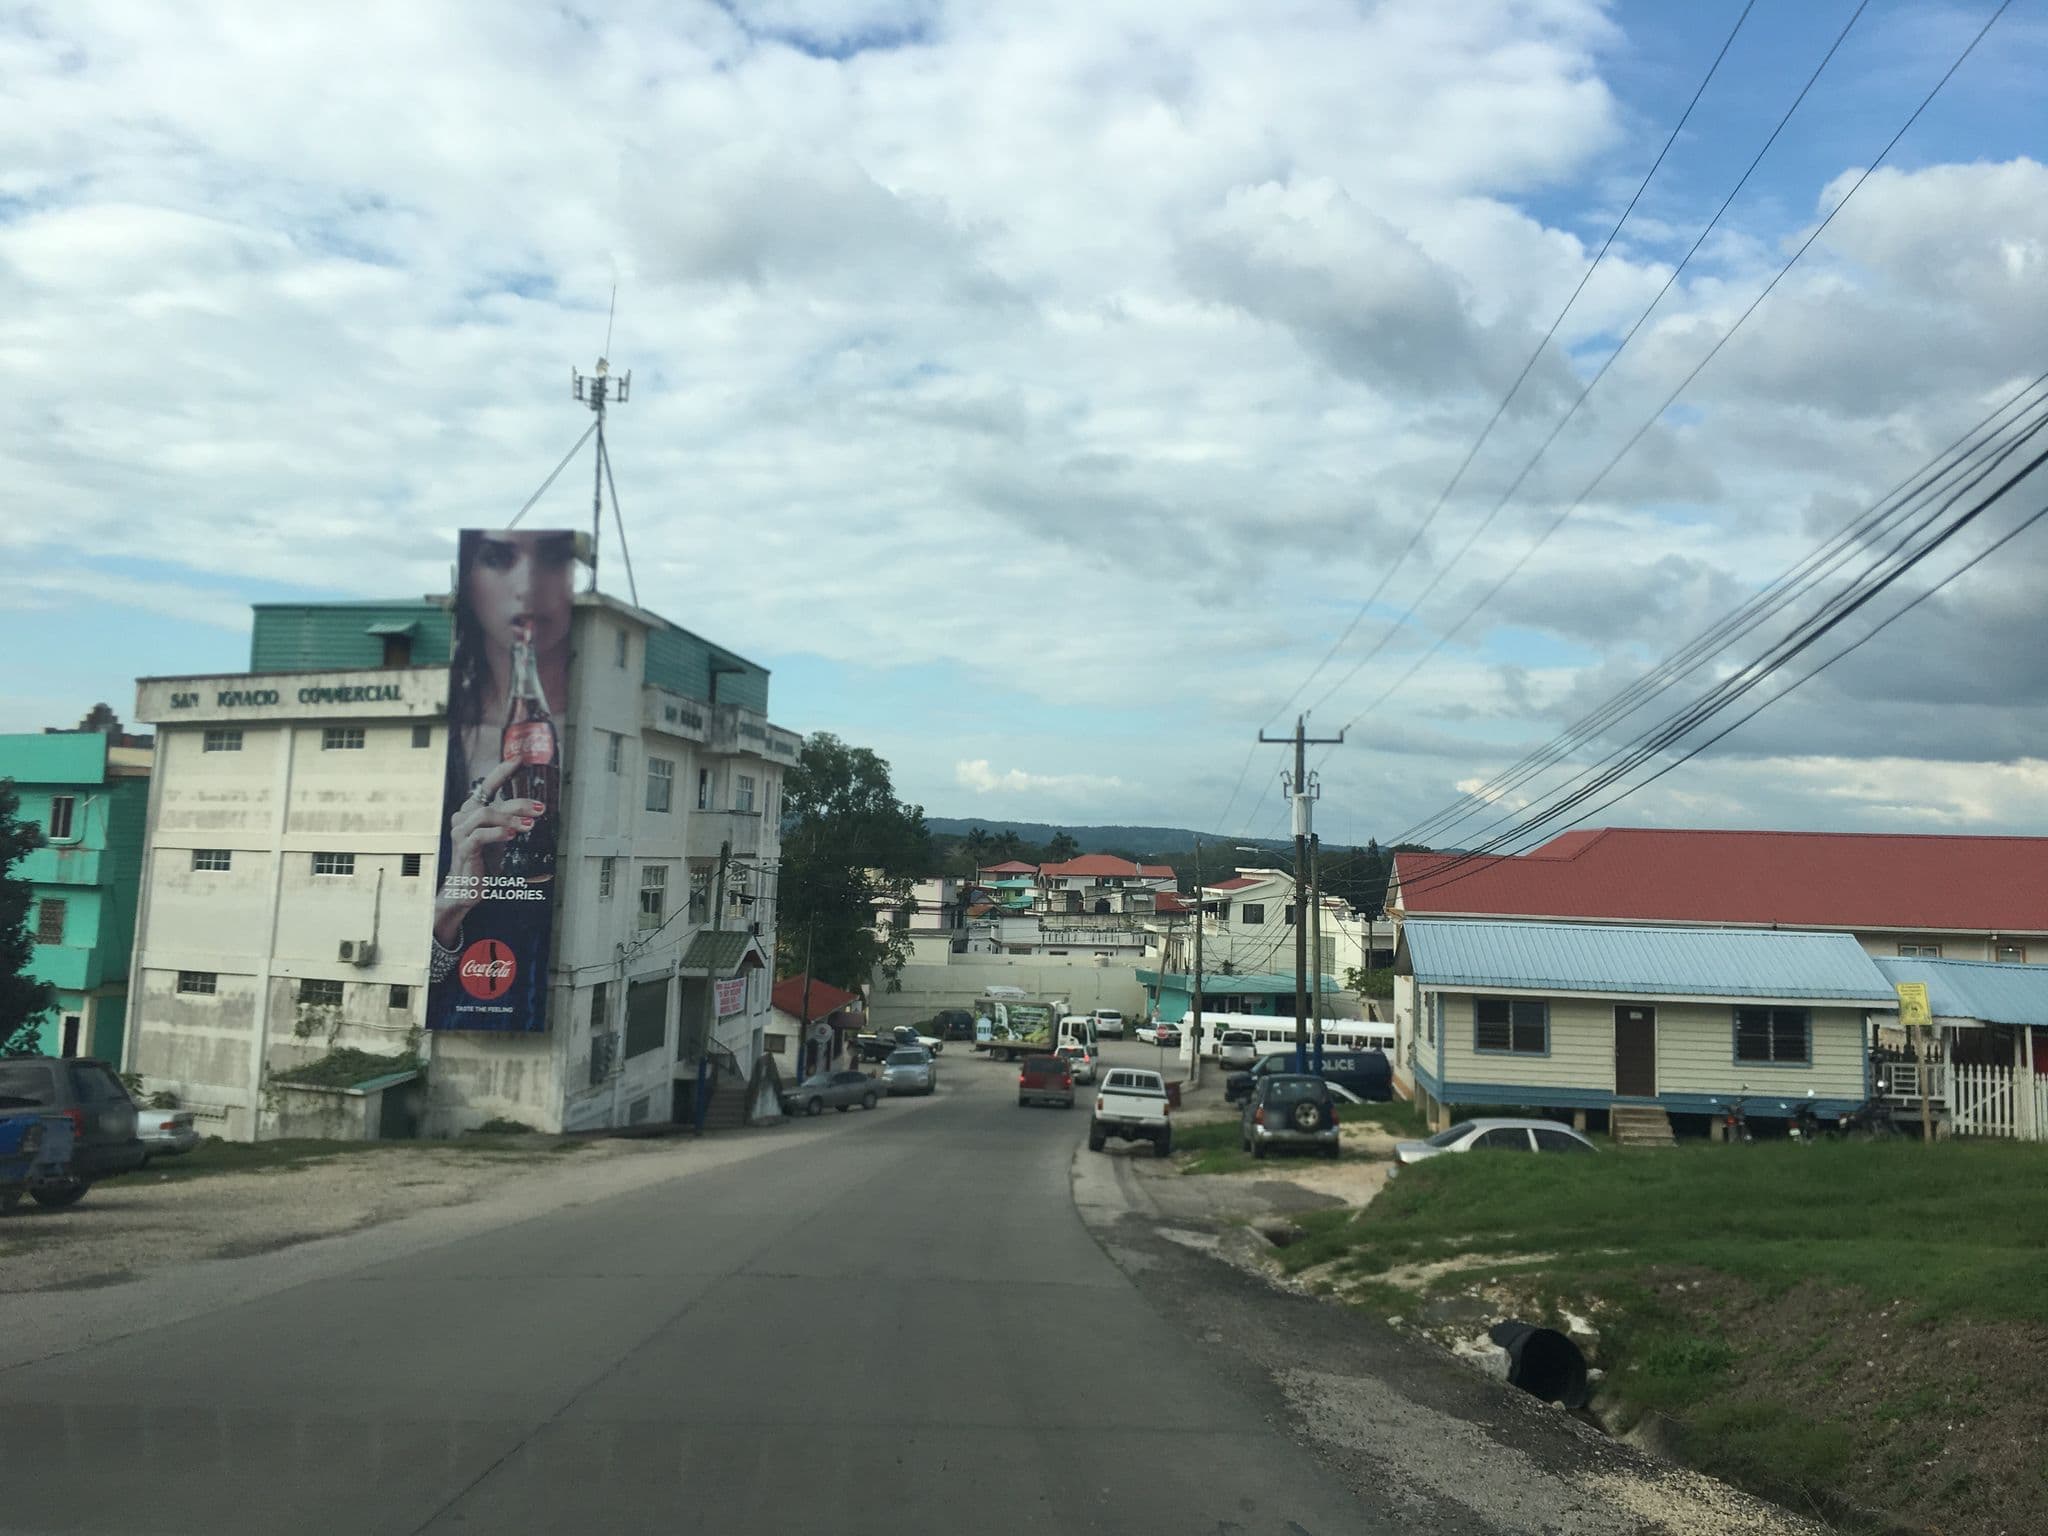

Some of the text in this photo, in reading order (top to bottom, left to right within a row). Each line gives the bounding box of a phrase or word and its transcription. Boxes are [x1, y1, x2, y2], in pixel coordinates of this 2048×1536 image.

[170, 684, 402, 709] SAN IGNACIO COMMERCIAL
[445, 875, 528, 889] ZERO SUGAR,
[444, 888, 546, 901] ZERO CALORIES.
